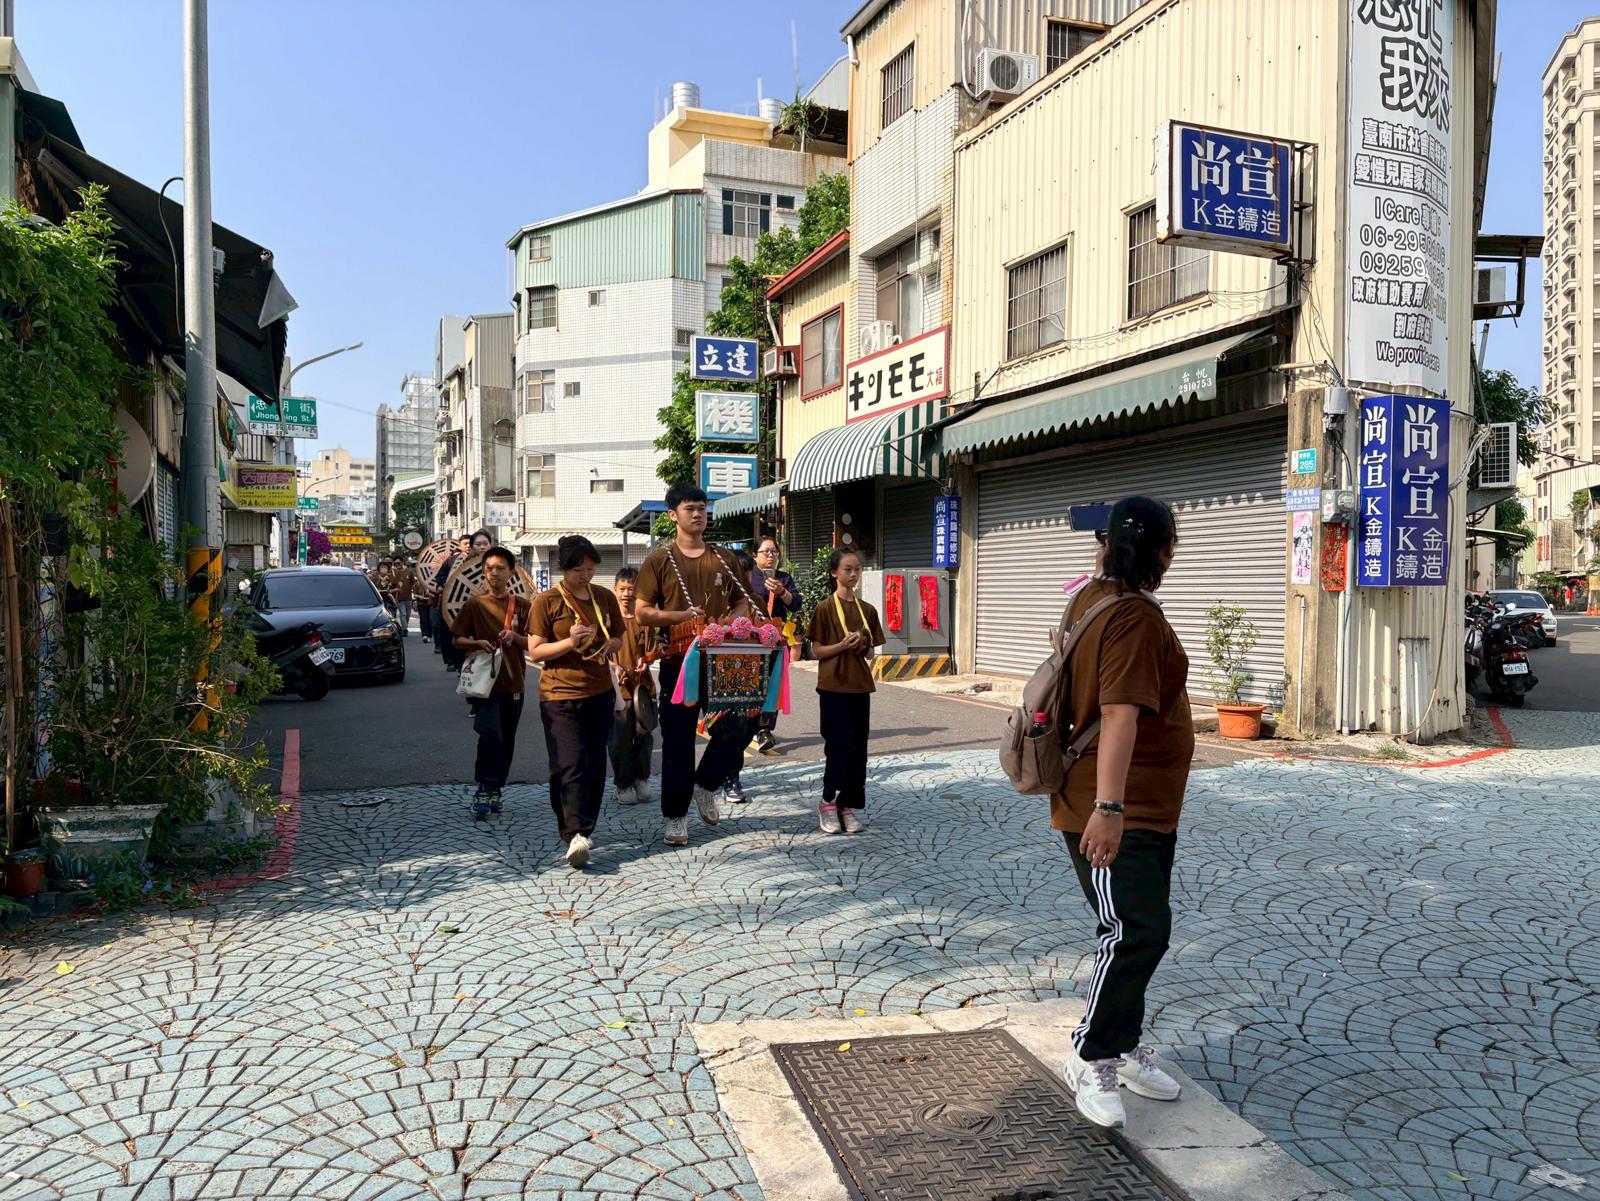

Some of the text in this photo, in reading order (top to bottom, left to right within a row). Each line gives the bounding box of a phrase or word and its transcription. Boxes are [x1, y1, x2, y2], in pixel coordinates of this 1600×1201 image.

[1380, 36, 1449, 134] 我來
[1191, 140, 1279, 201] 尚宣
[1192, 198, 1280, 236] K金鑄造
[1383, 197, 1420, 225] Care
[699, 344, 753, 376] 立達
[1376, 341, 1395, 362] We
[704, 399, 754, 435] 機
[706, 461, 752, 494] 車
[1300, 460, 1314, 469] 285
[1402, 404, 1440, 519] 尚宣
